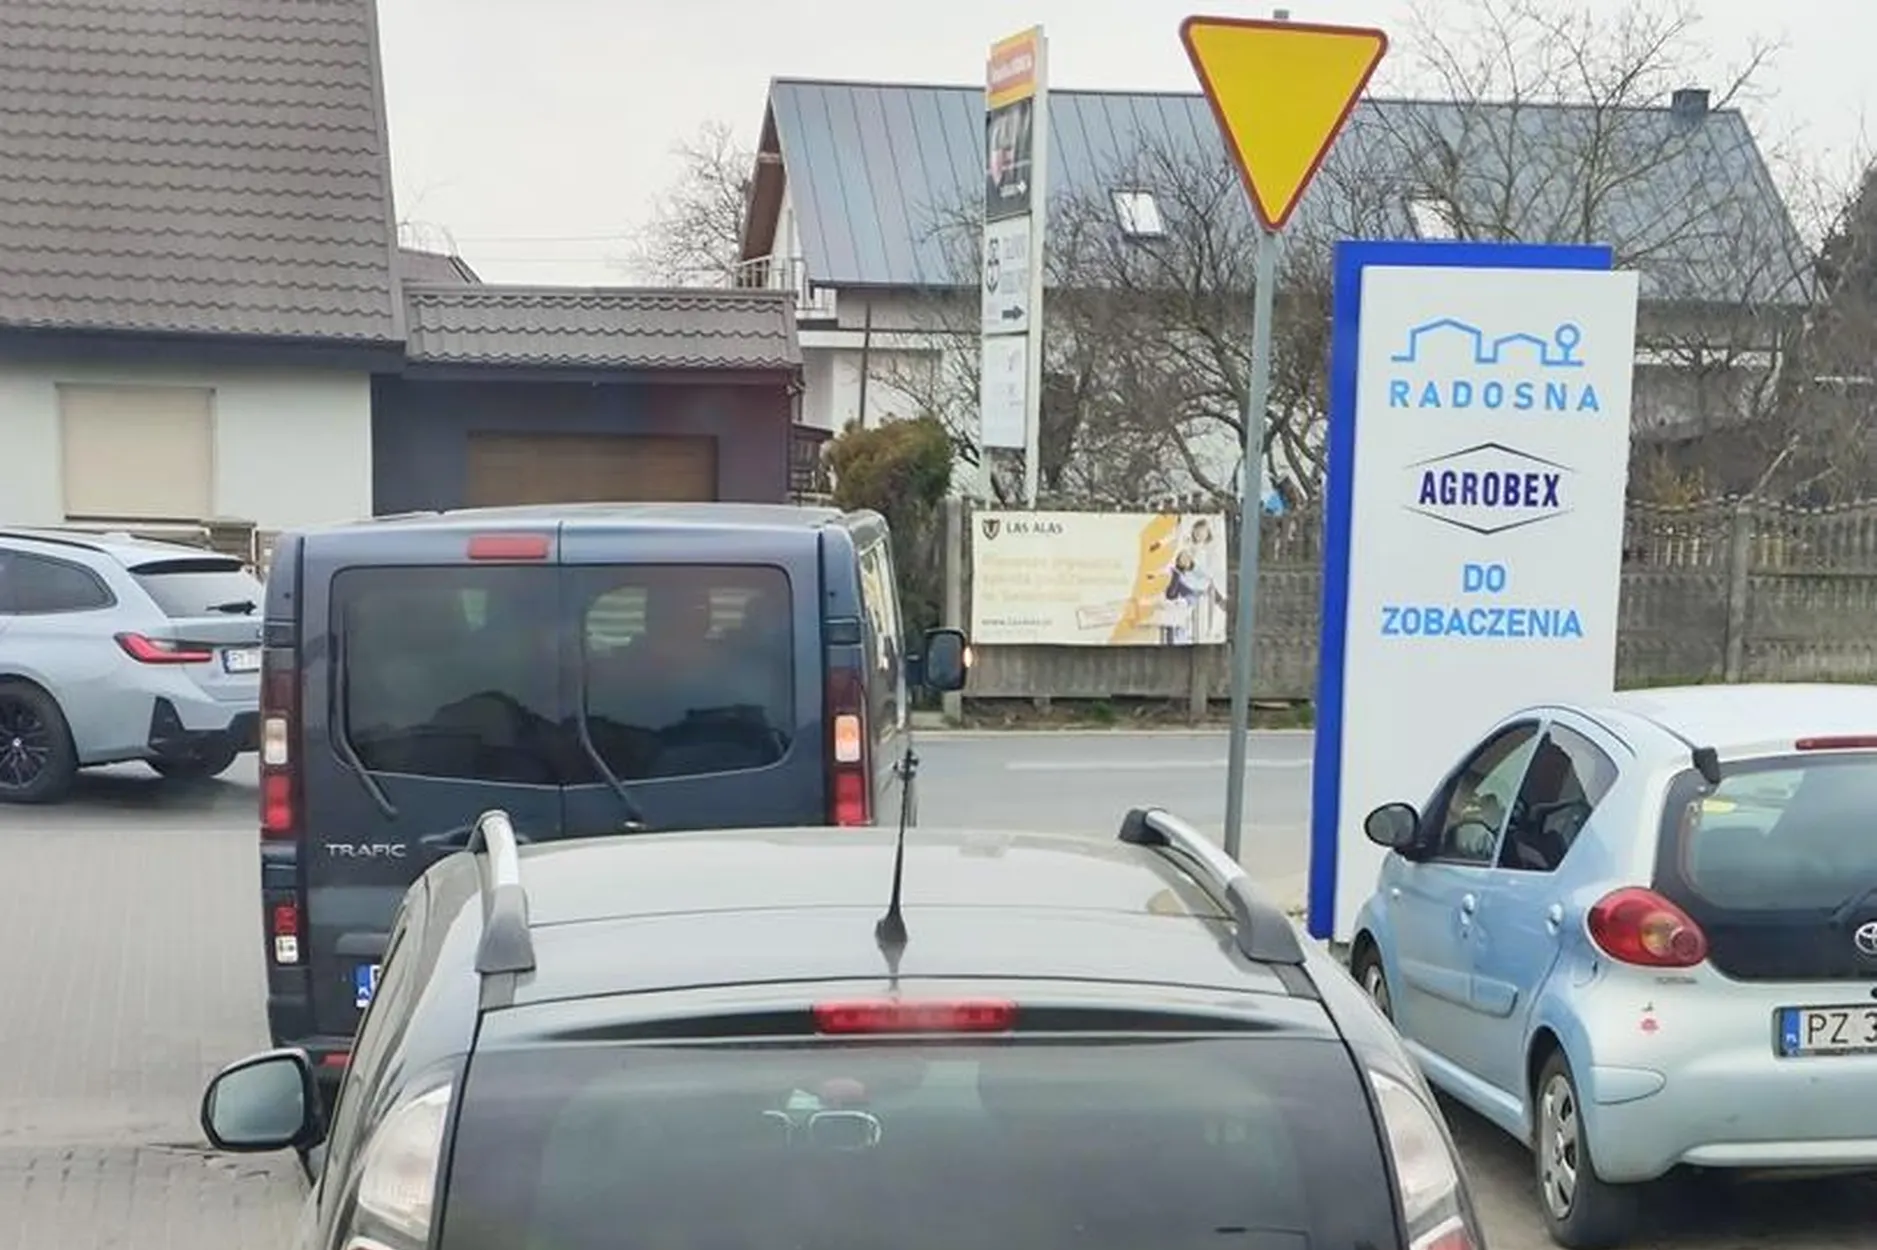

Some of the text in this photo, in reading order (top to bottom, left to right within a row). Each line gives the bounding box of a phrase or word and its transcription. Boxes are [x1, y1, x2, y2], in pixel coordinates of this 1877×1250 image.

[1389, 380, 1600, 412] RADOSNA
[1418, 469, 1560, 507] AGROBEX
[1006, 521, 1029, 535] LAS
[1462, 563, 1506, 594] DO
[1381, 606, 1583, 638] ZOBACZENIA
[325, 843, 407, 858] TRAFIC
[1807, 1012, 1849, 1045] PZ
